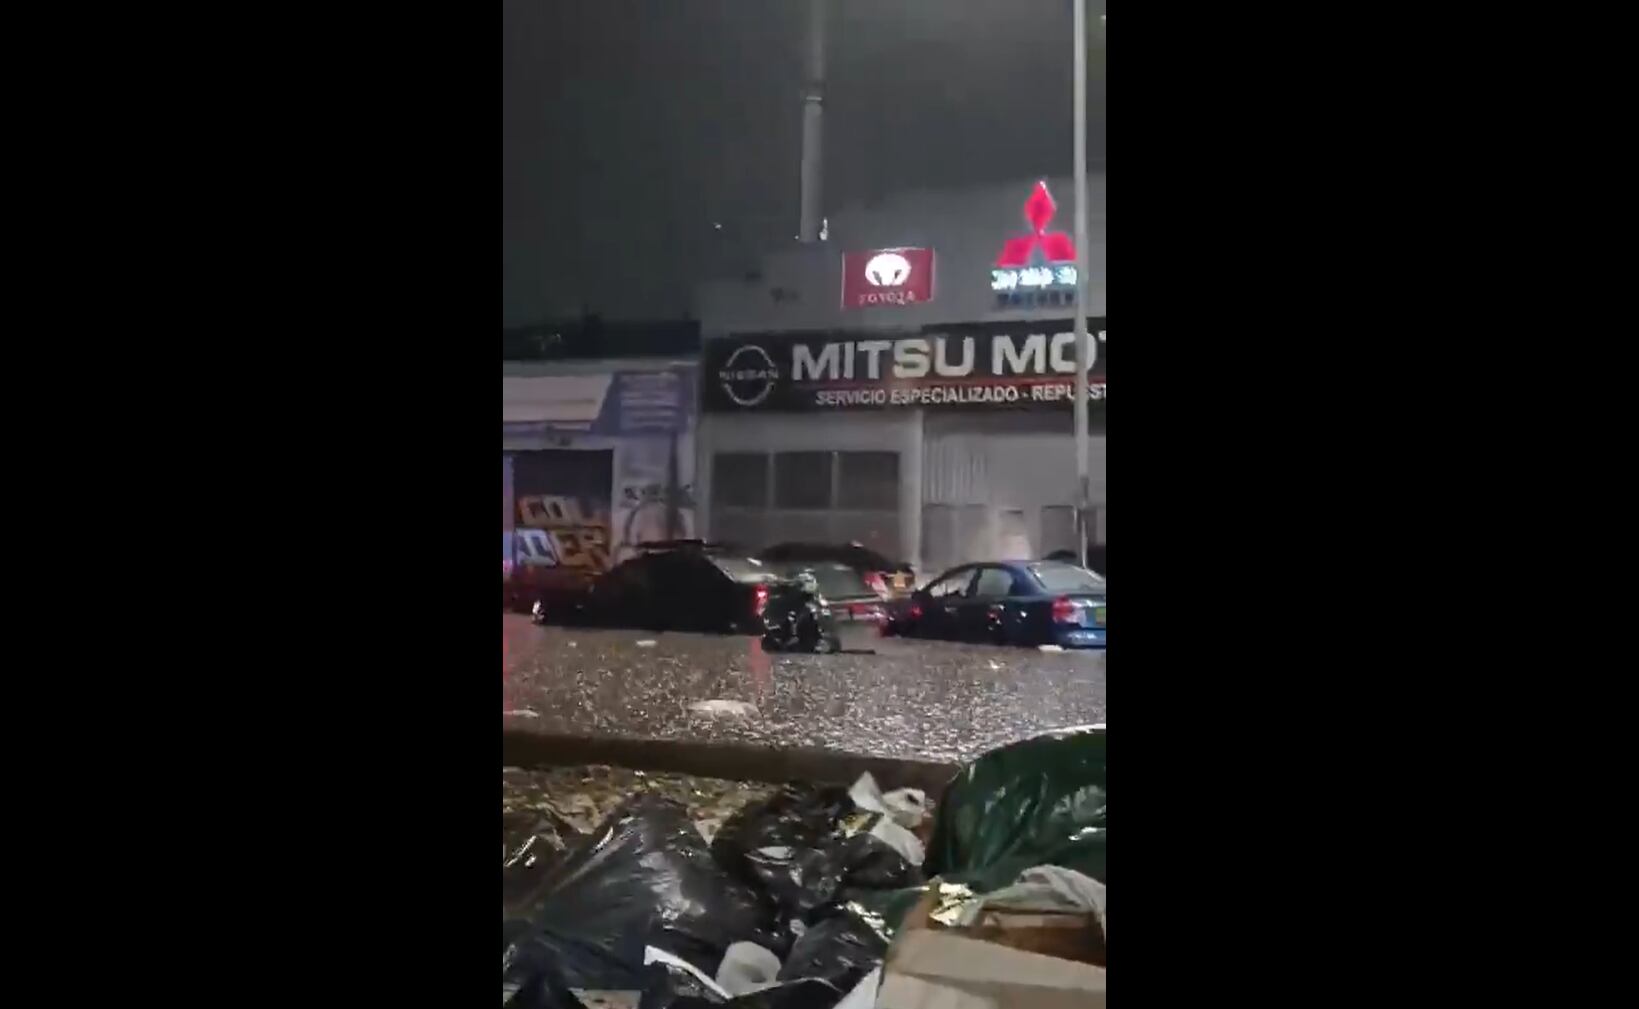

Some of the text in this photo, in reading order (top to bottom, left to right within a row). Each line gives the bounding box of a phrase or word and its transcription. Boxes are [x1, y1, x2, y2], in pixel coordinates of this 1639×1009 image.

[792, 339, 975, 381] MITSU
[815, 388, 886, 406] SERVICIO
[891, 386, 1018, 405] ESPECIALIZADO
